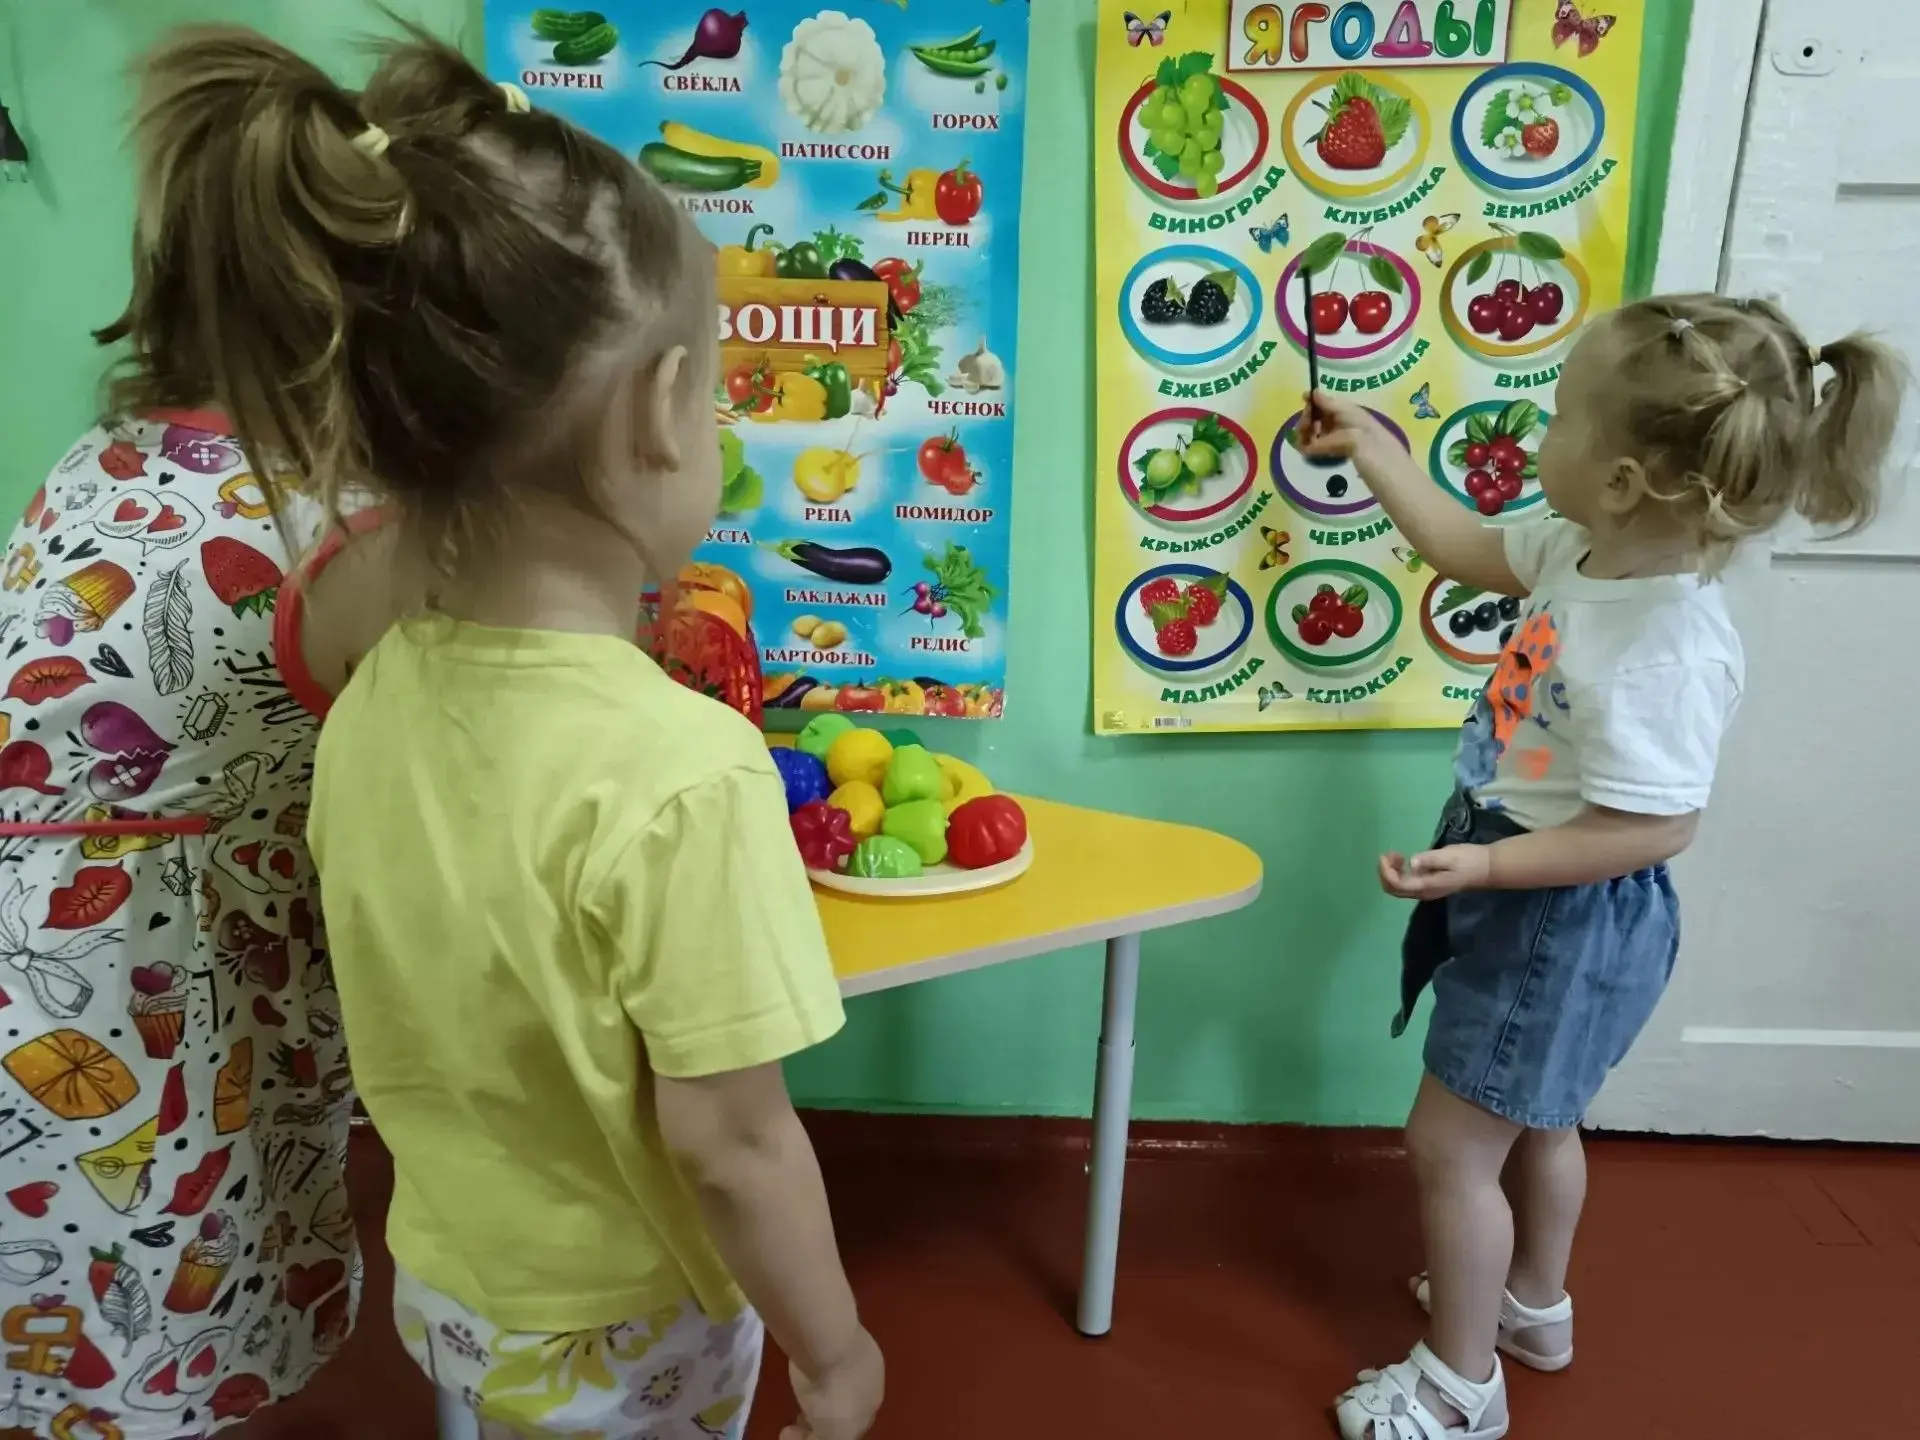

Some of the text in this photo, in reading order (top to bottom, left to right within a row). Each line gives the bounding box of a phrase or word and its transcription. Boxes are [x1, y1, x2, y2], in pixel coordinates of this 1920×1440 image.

[1243, 0, 1493, 65] ЯГОДЫ
[522, 71, 604, 90] ОГУРЕЦ
[663, 72, 741, 93] СВЁКЛА
[932, 114, 998, 131] ГОРОХ
[781, 142, 890, 160] ПАТИССОН
[1323, 165, 1446, 225] КЛУБНИКА
[1482, 157, 1617, 218] ЗЕМЛЯНИКА
[1148, 165, 1286, 234] ВИНОГРАД
[906, 231, 969, 248] ПЕРЕЦ
[1157, 340, 1278, 398] ЕЖЕВИКА
[1319, 337, 1431, 392] ЧЕРЕШНЯ
[1494, 362, 1561, 388] ВИШ
[927, 400, 1006, 418] ЧЕСНОК
[805, 507, 852, 523] РЕПА
[895, 505, 994, 522] ПОМИДОР
[1139, 490, 1273, 552] КРЫЖОВНИК
[1308, 515, 1391, 546] ЧЕРНИ
[786, 589, 887, 606] БАКЛАЖАН
[911, 637, 971, 653] РЕДИС
[765, 648, 876, 666] КАРТОФЕЛЬ
[1160, 656, 1265, 704] МАЛИНА
[1305, 655, 1413, 705] КЛЮКВА
